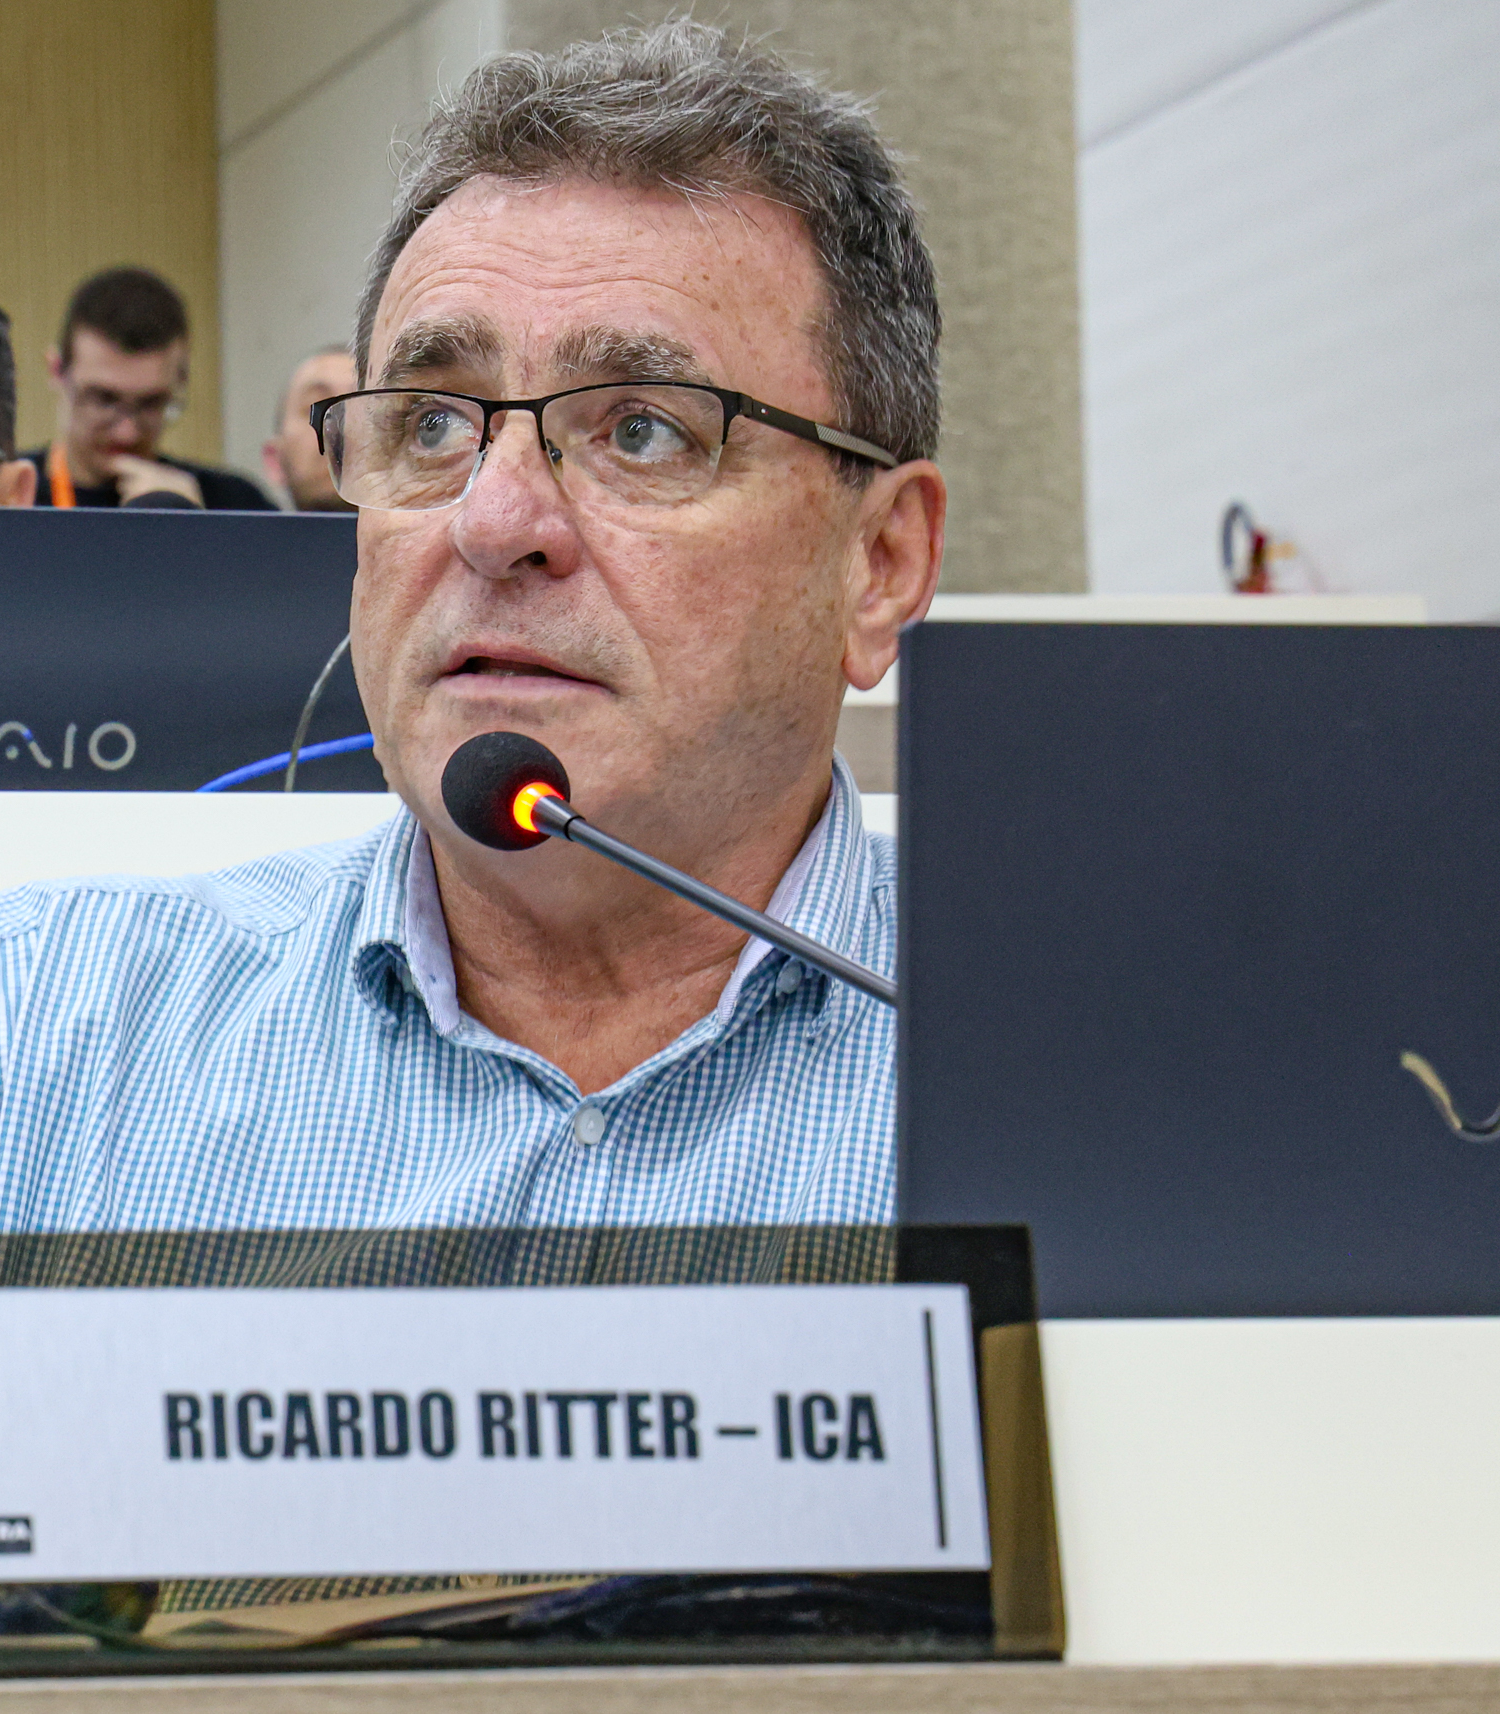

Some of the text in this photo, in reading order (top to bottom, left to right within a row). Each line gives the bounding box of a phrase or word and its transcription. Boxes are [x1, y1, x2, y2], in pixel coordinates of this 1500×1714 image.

[164, 1391, 457, 1461] RICARDO
[478, 1391, 700, 1460] RITTER
[774, 1392, 885, 1462] ICA
